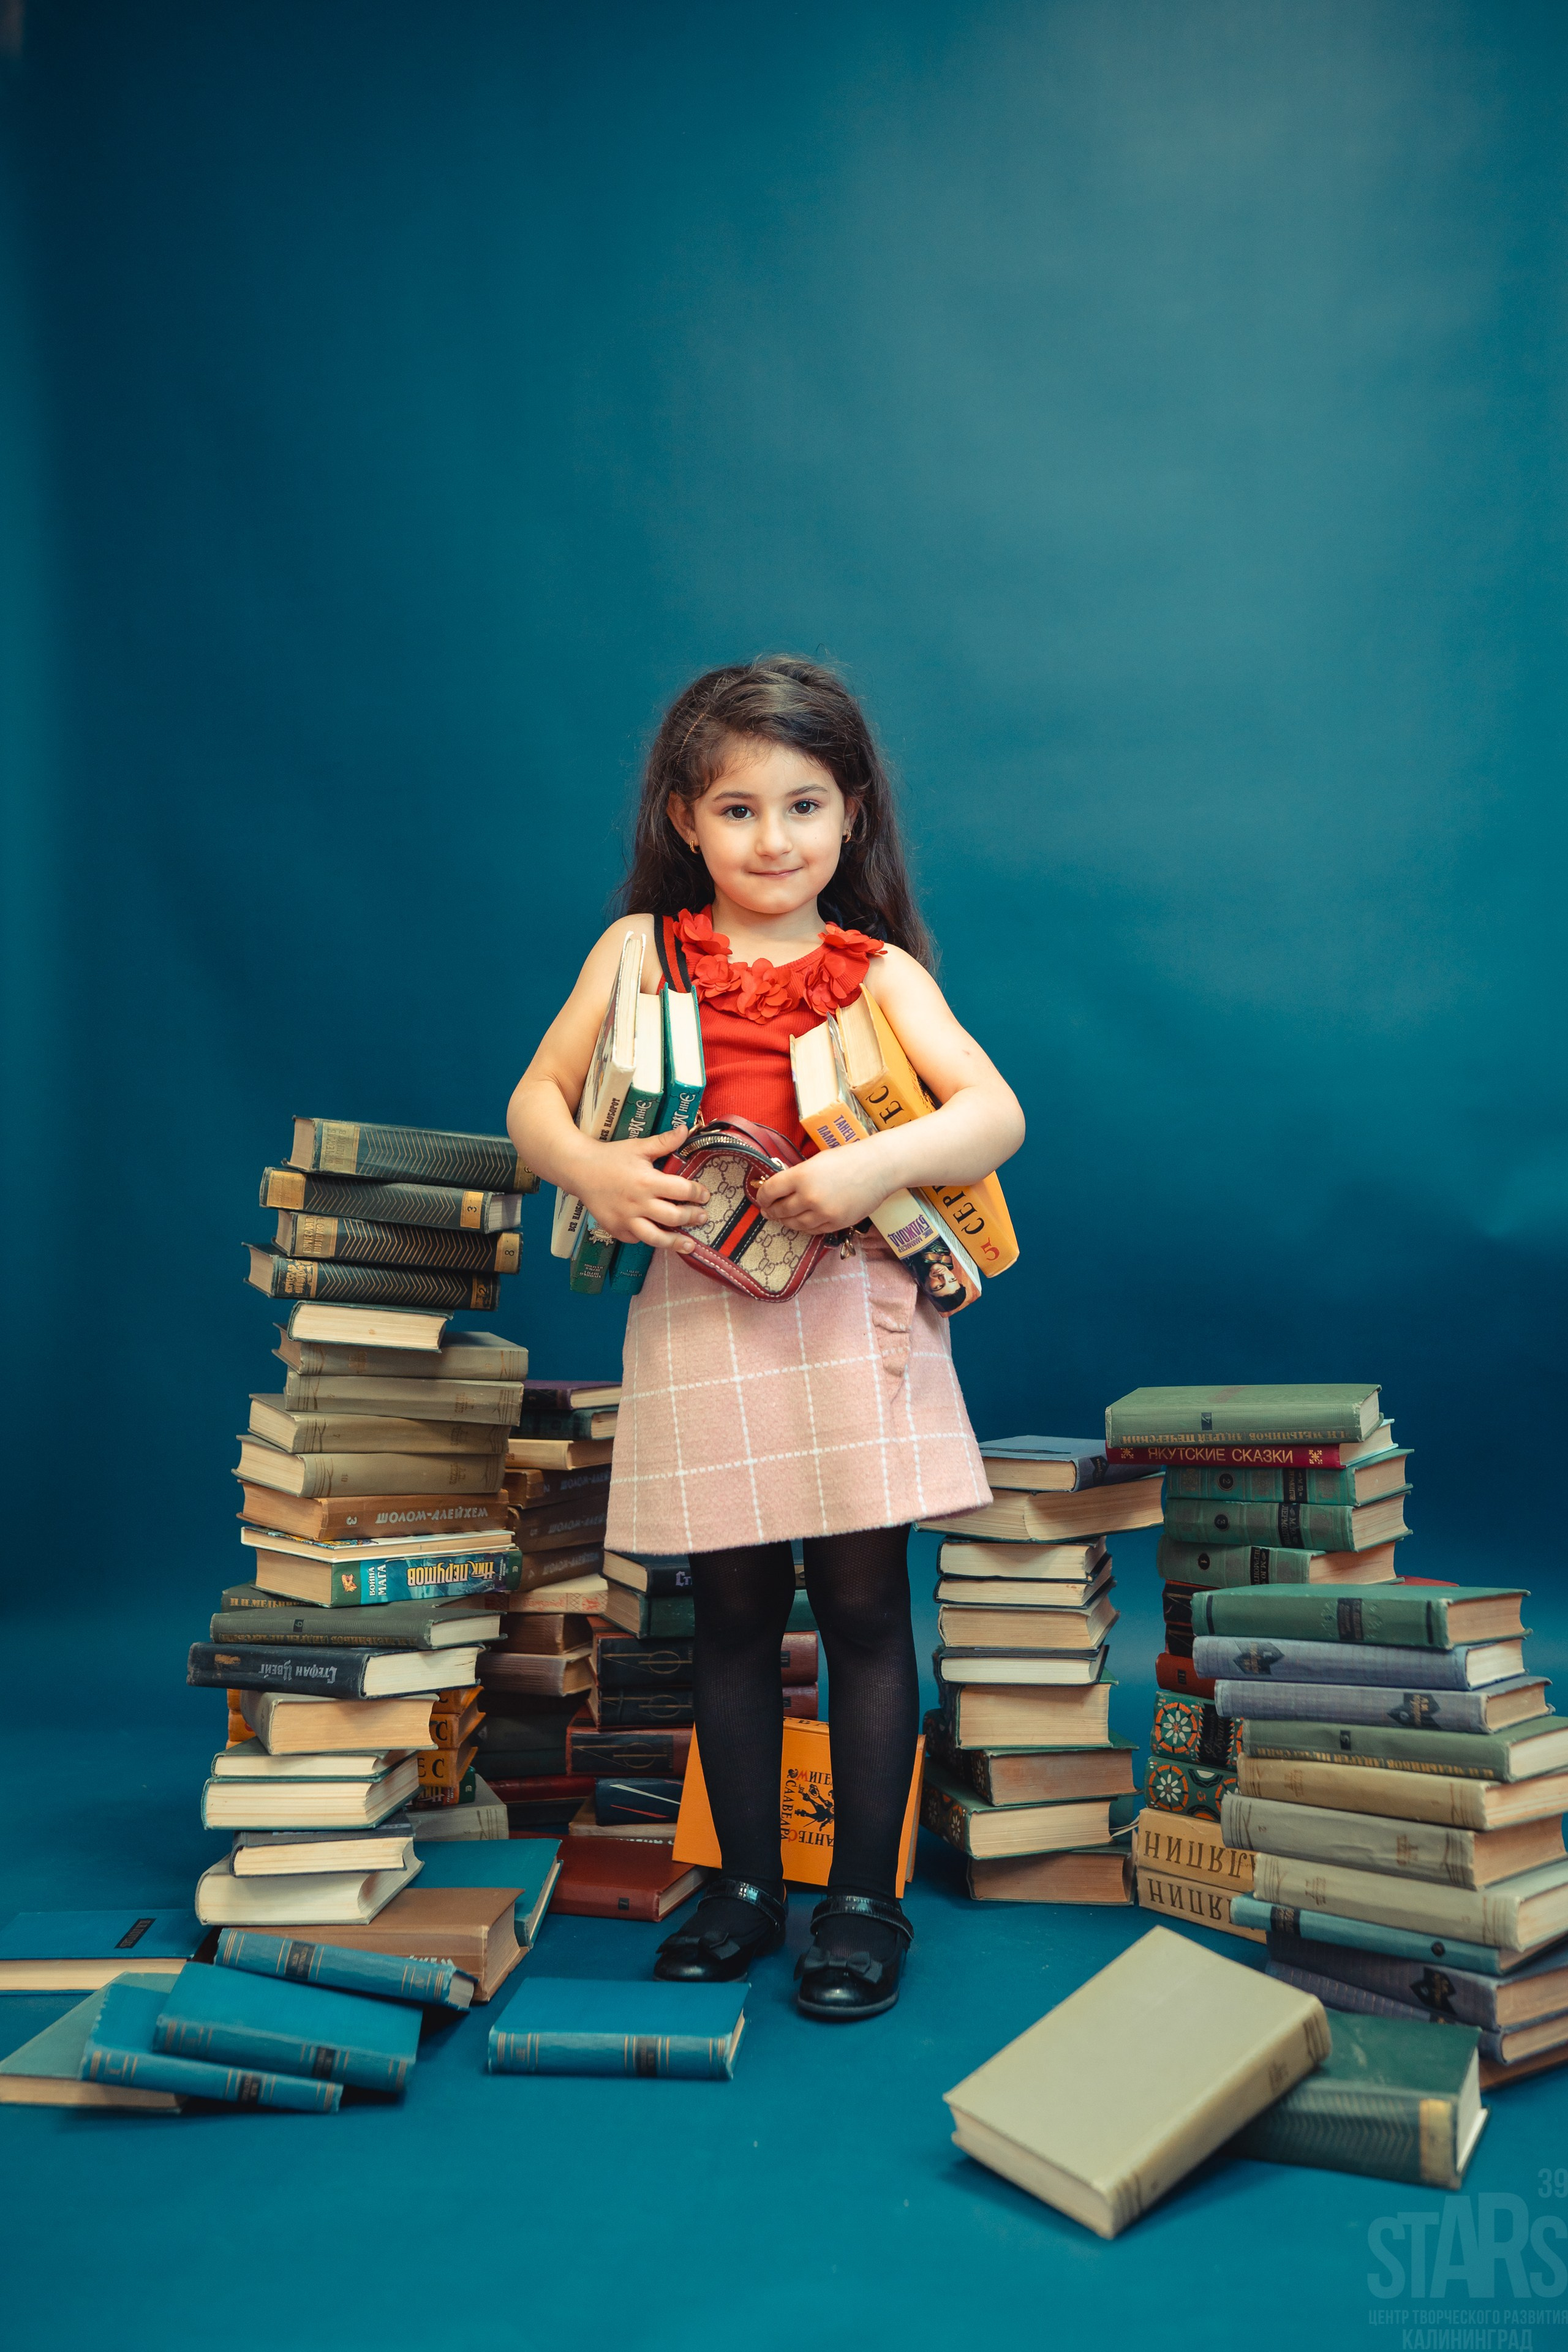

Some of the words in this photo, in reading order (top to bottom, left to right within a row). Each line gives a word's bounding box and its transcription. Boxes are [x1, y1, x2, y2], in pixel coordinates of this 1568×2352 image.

[604, 1098, 620, 1128] НАОБОРОТ
[635, 1099, 652, 1121] Энн
[679, 1093, 696, 1112] Энн
[628, 1118, 646, 1139] Мак
[672, 1110, 690, 1131] Ма
[833, 1115, 857, 1142] ТАНЕЦ
[600, 1129, 609, 1142] ВСЕ
[817, 1125, 842, 1149] ПАМЯ
[572, 1199, 584, 1219] НАОБО
[303, 1216, 314, 1254] ВЯЧЕСЛАВ
[313, 1217, 325, 1254] ШИШКОВ
[888, 1214, 930, 1247] БУДЖОЛД
[898, 1236, 924, 1253] МАКМАСТЕР
[981, 1237, 1000, 1261] 5
[1148, 1447, 1226, 1461] ЯКУТСКИЕ
[1232, 1448, 1294, 1464] СКАЗКИ
[1223, 1477, 1231, 1485] 2
[346, 1516, 358, 1525] 3
[375, 1506, 488, 1524] ШОЛОМ-АЛЕЙХЕМ
[1281, 1505, 1292, 1547] ЛЕРМОНТОВ
[377, 1564, 387, 1596] МАГА
[1178, 1671, 1187, 1684] 10
[797, 1770, 834, 1785] МИГЕ
[788, 1829, 834, 1847] АНТЕС
